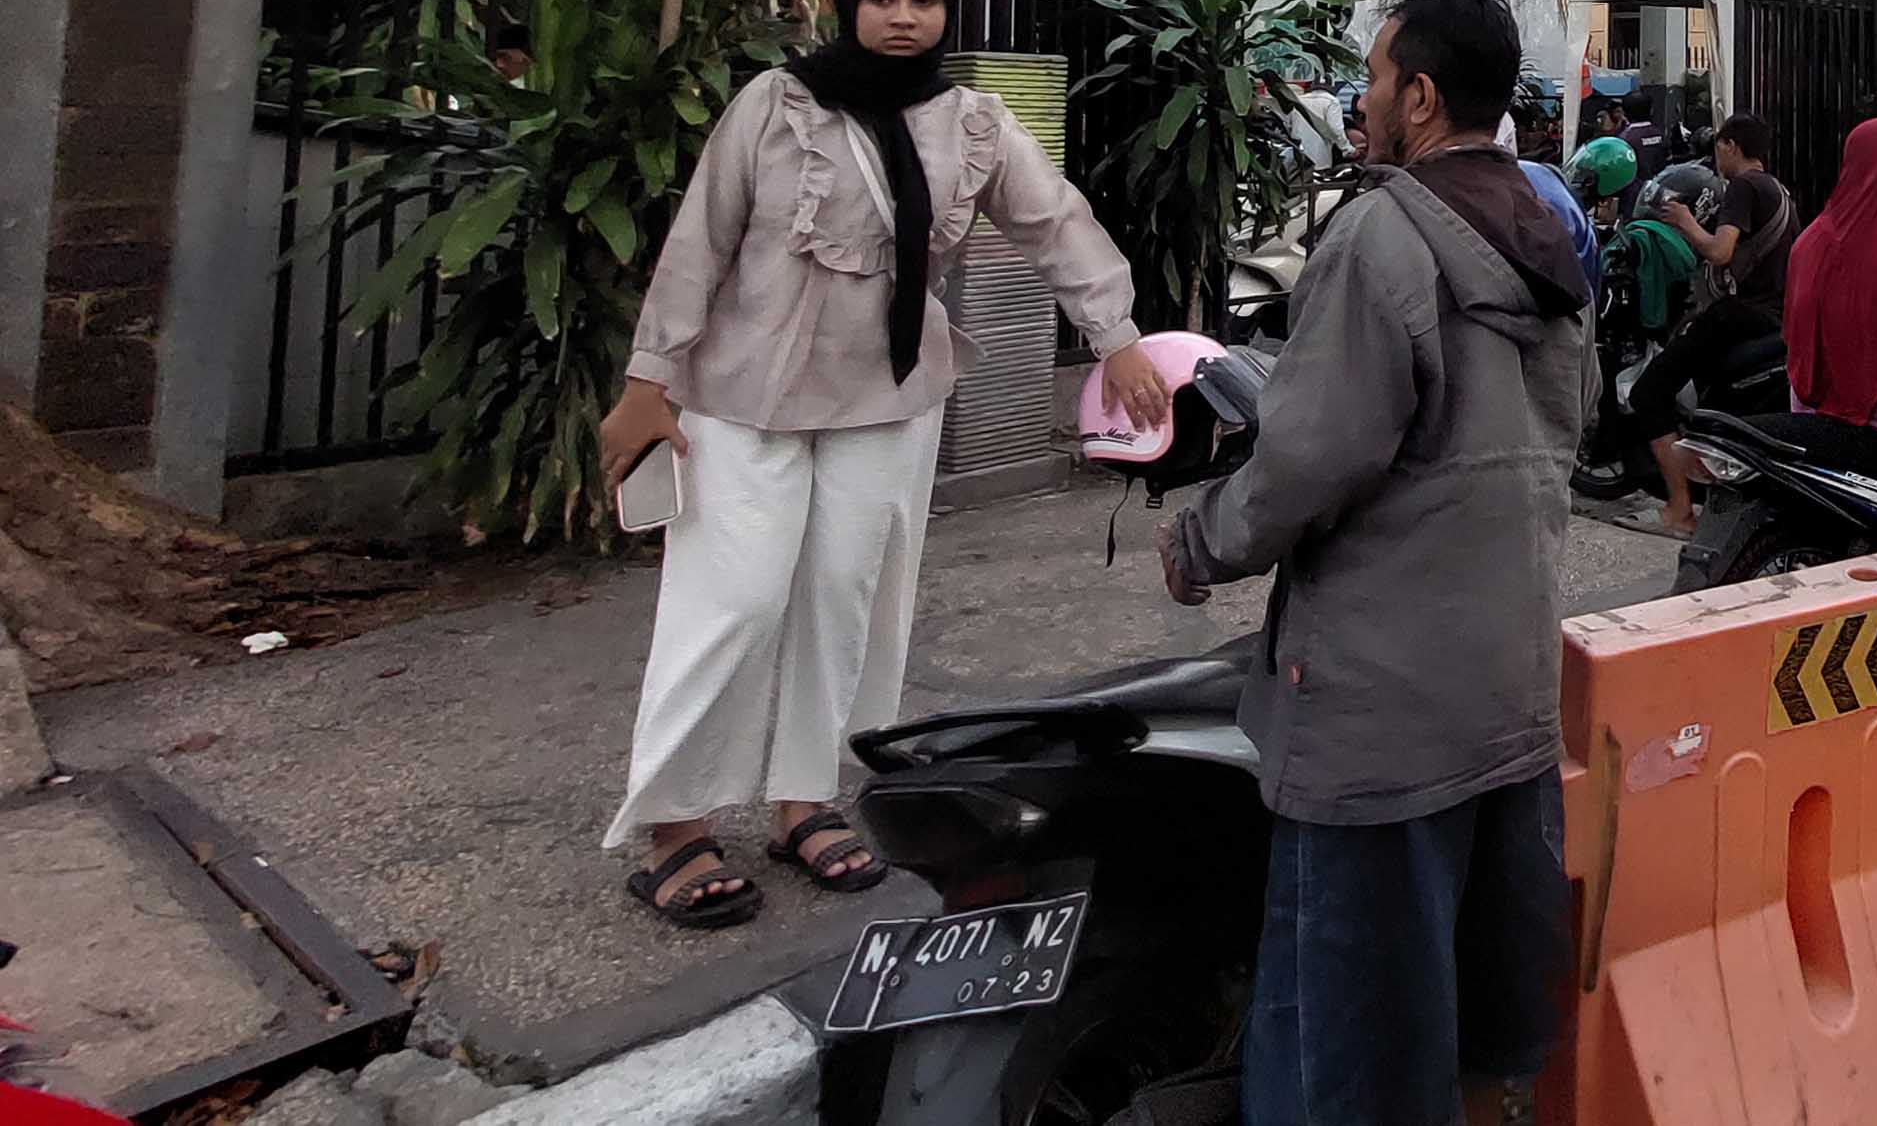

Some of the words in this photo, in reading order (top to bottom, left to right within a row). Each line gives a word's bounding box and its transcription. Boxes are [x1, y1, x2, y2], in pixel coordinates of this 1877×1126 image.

[861, 933, 891, 973] N
[915, 917, 997, 966] 4071
[1023, 906, 1074, 950] NZ
